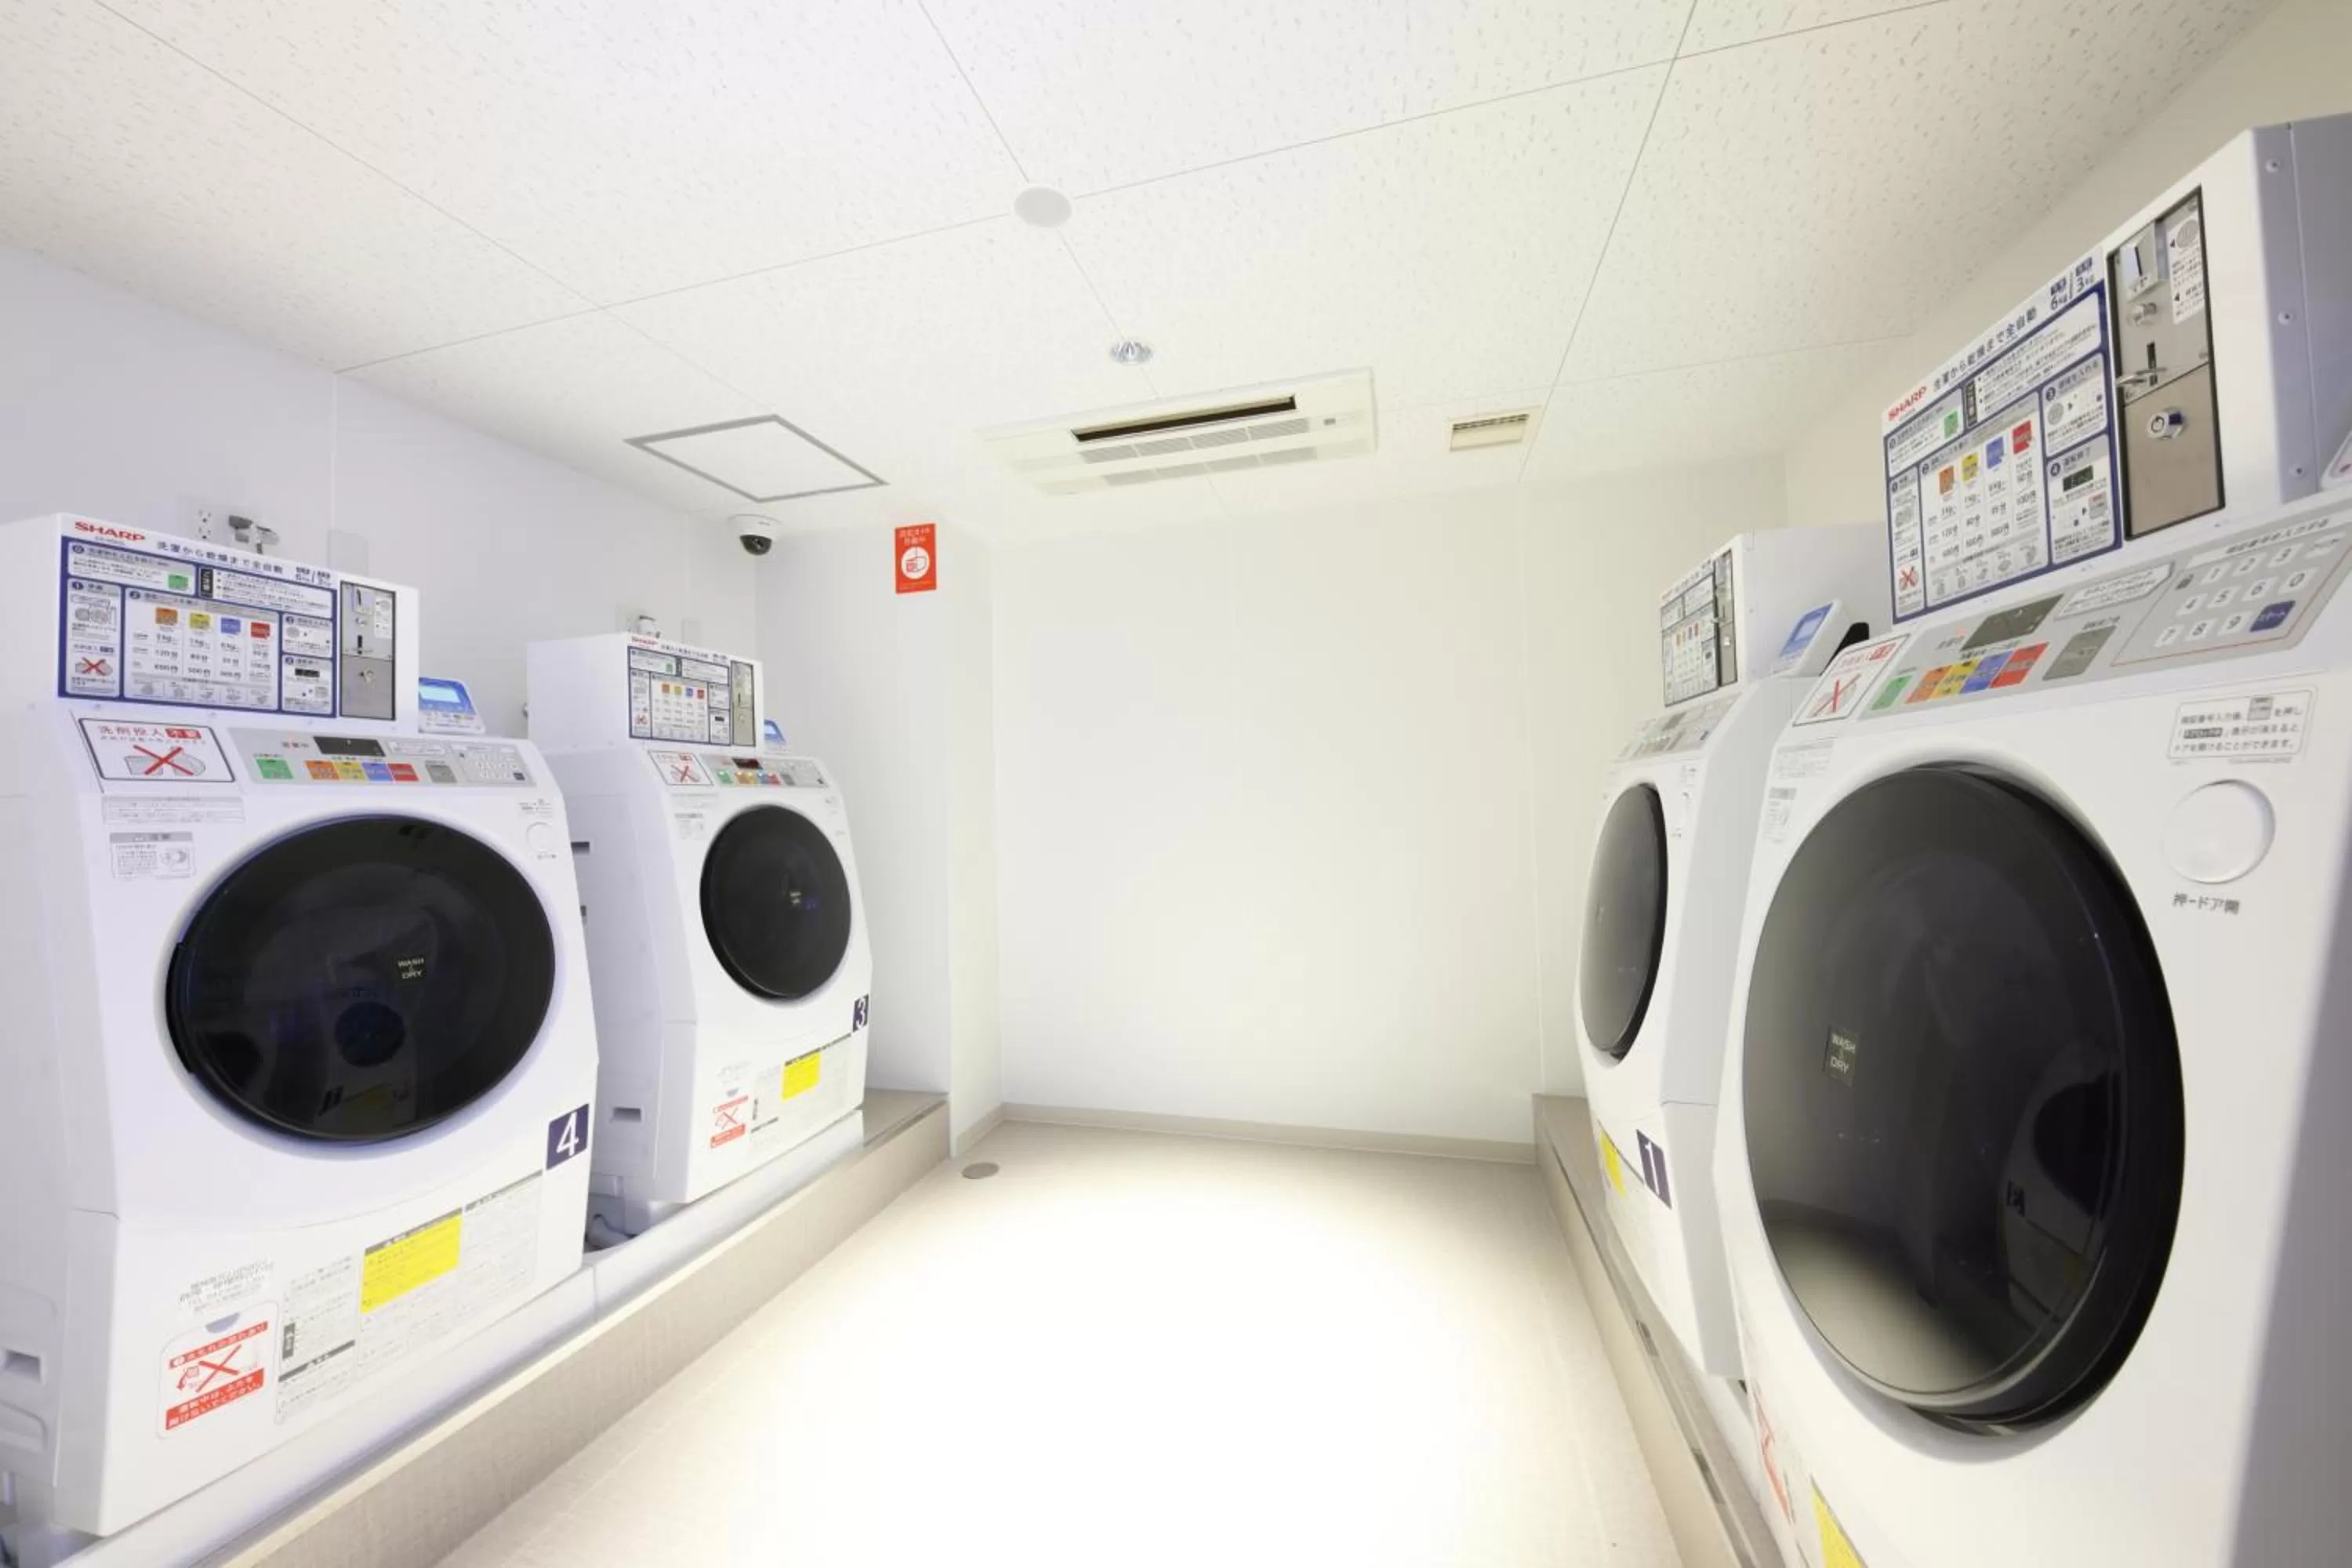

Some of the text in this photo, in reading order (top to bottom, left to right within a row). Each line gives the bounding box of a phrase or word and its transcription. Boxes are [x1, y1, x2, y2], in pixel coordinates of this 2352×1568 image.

[1887, 386, 1927, 420] SHARP
[74, 521, 147, 542] SHARP
[856, 997, 866, 1029] 3
[1832, 1034, 1857, 1054] WASH
[1831, 1055, 1849, 1075] DRY
[556, 1110, 580, 1157] 4
[1644, 1141, 1661, 1196] 1
